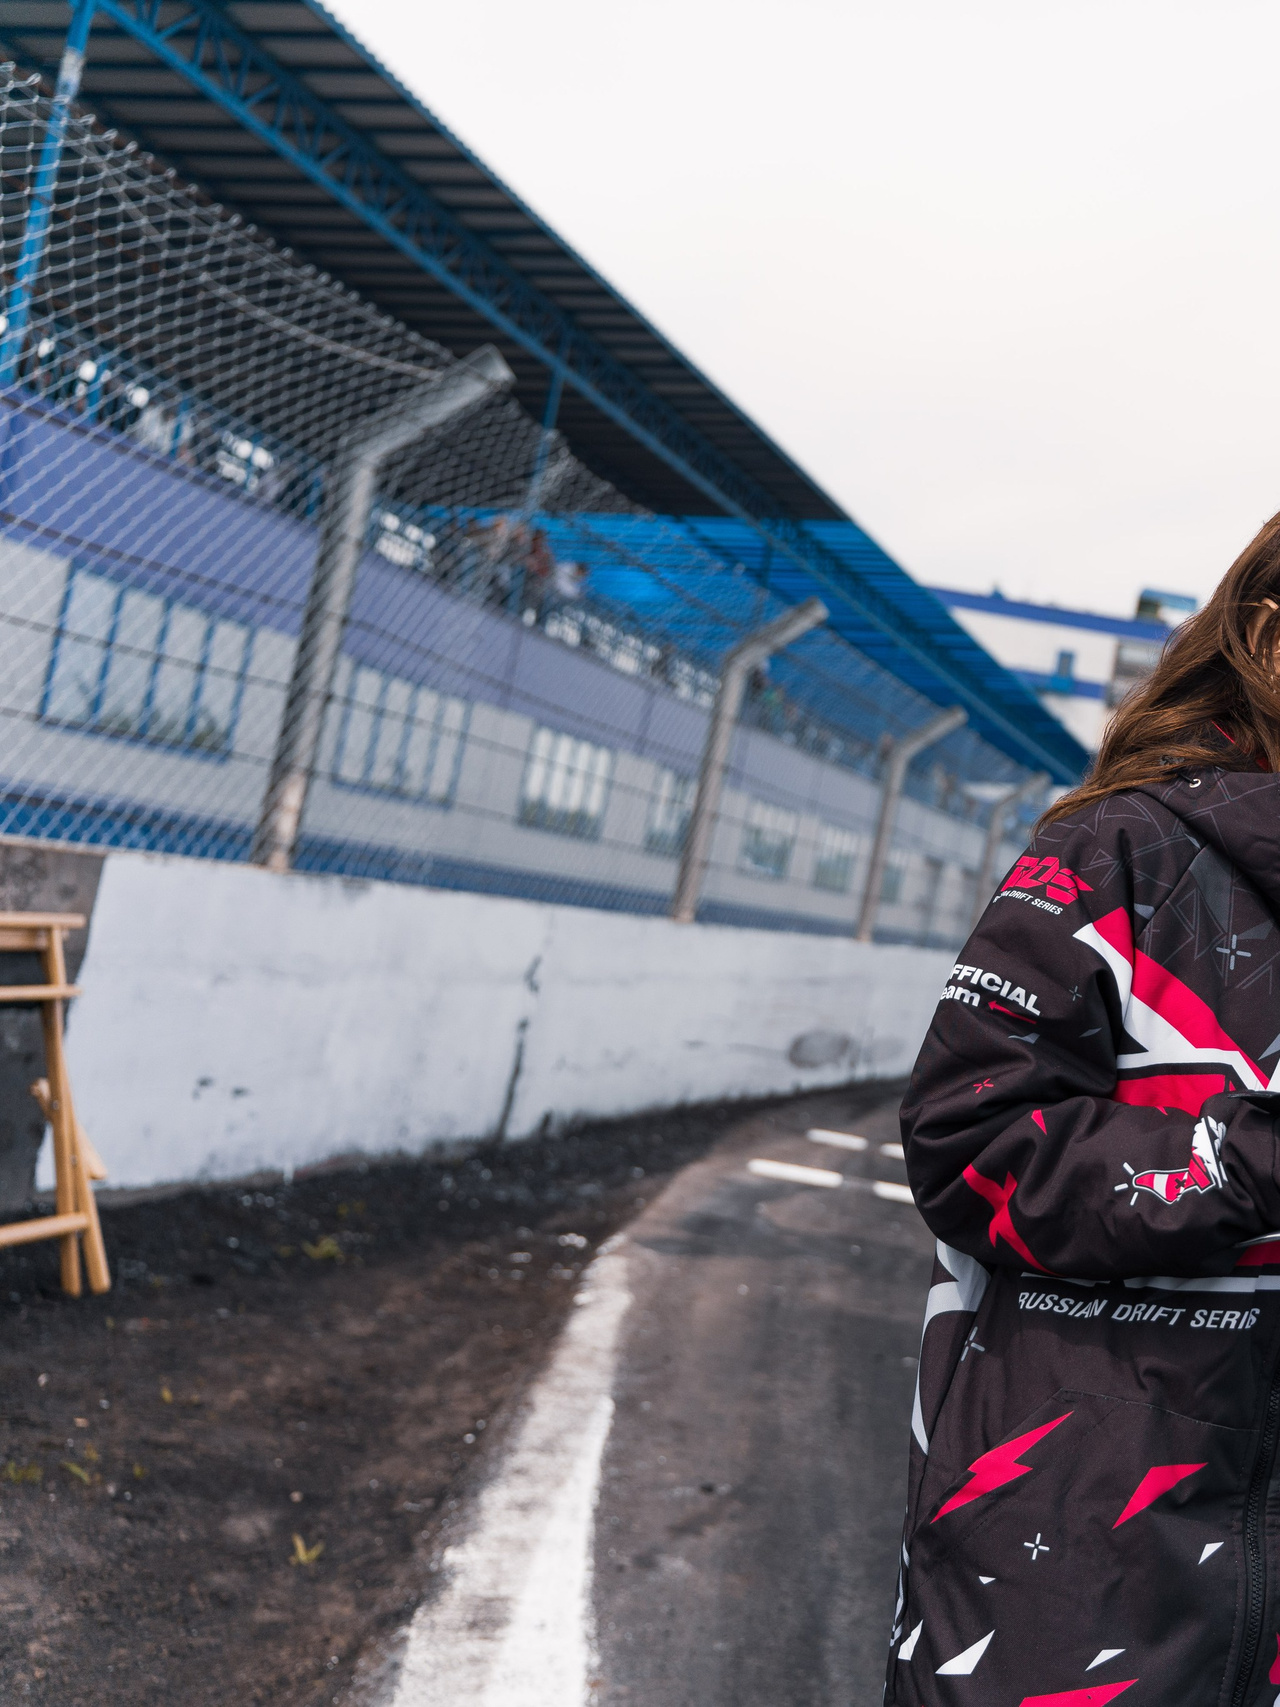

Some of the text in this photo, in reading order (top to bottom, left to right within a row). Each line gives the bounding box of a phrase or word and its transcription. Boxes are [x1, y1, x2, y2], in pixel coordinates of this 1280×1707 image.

[1008, 890, 1034, 902] DRIFT
[1031, 898, 1064, 916] SERIES
[940, 985, 981, 1007] eam
[949, 963, 1041, 1016] FFICIAL
[1018, 1292, 1109, 1318] RUSSIAN
[1111, 1303, 1186, 1325] DRIFT
